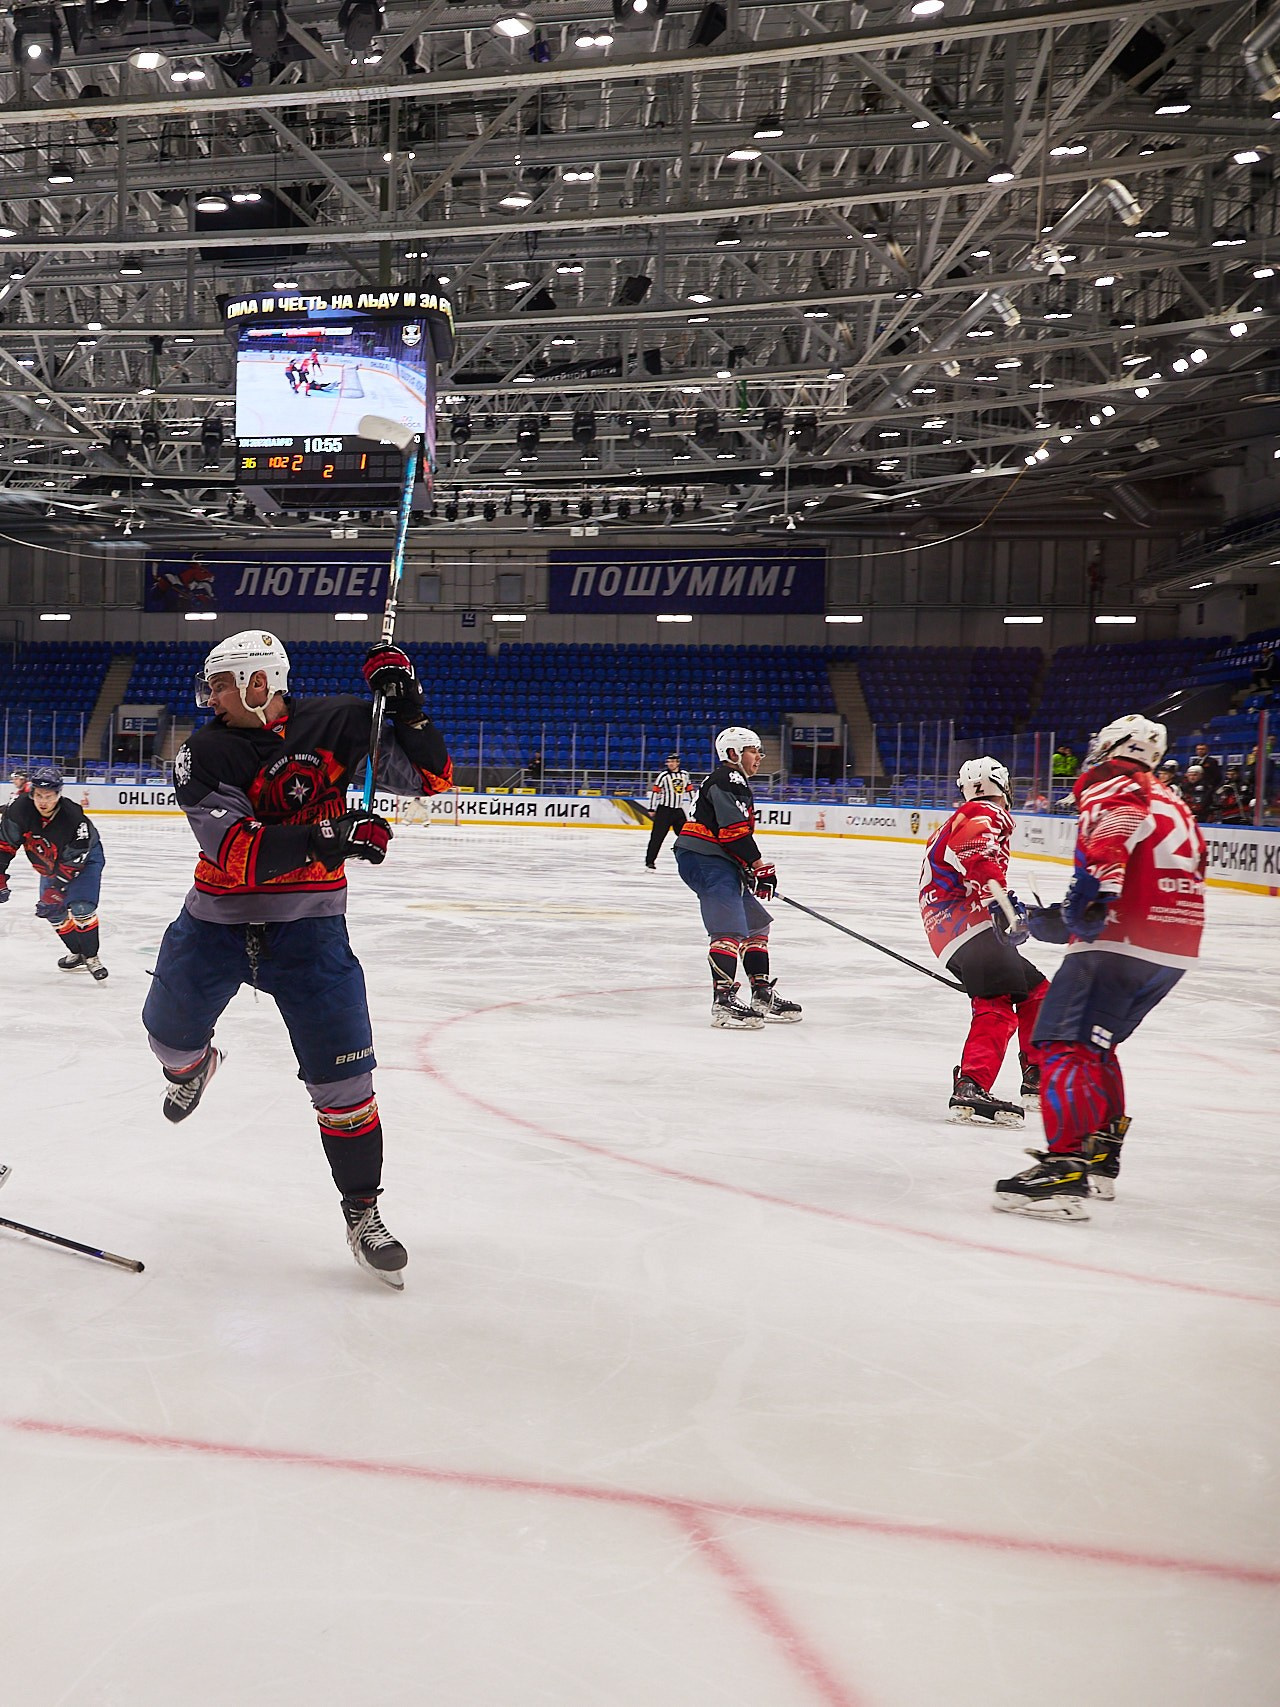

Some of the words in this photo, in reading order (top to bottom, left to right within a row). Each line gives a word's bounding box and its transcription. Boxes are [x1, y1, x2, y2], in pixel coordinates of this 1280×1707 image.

[262, 297, 275, 313] И
[278, 296, 328, 312] ЧЕСТЬ
[332, 294, 354, 309] НА
[357, 293, 400, 309] ЛЬДУ
[404, 292, 416, 307] И
[420, 293, 438, 309] ЗА
[304, 437, 343, 453] 10:55
[241, 457, 257, 469] 36
[291, 454, 304, 471] 2
[360, 453, 367, 470] 1
[323, 464, 334, 478] 2
[234, 567, 382, 597] ЛЮТЫЕ!
[570, 565, 797, 597] ПОШУМИМ!
[295, 754, 320, 766] НОВГОРОД
[119, 791, 177, 805] OHLIGA
[431, 798, 537, 817] ХОККЕЙНАЯ
[545, 803, 590, 818] ЛИГА
[861, 817, 897, 827] АЛРОСА
